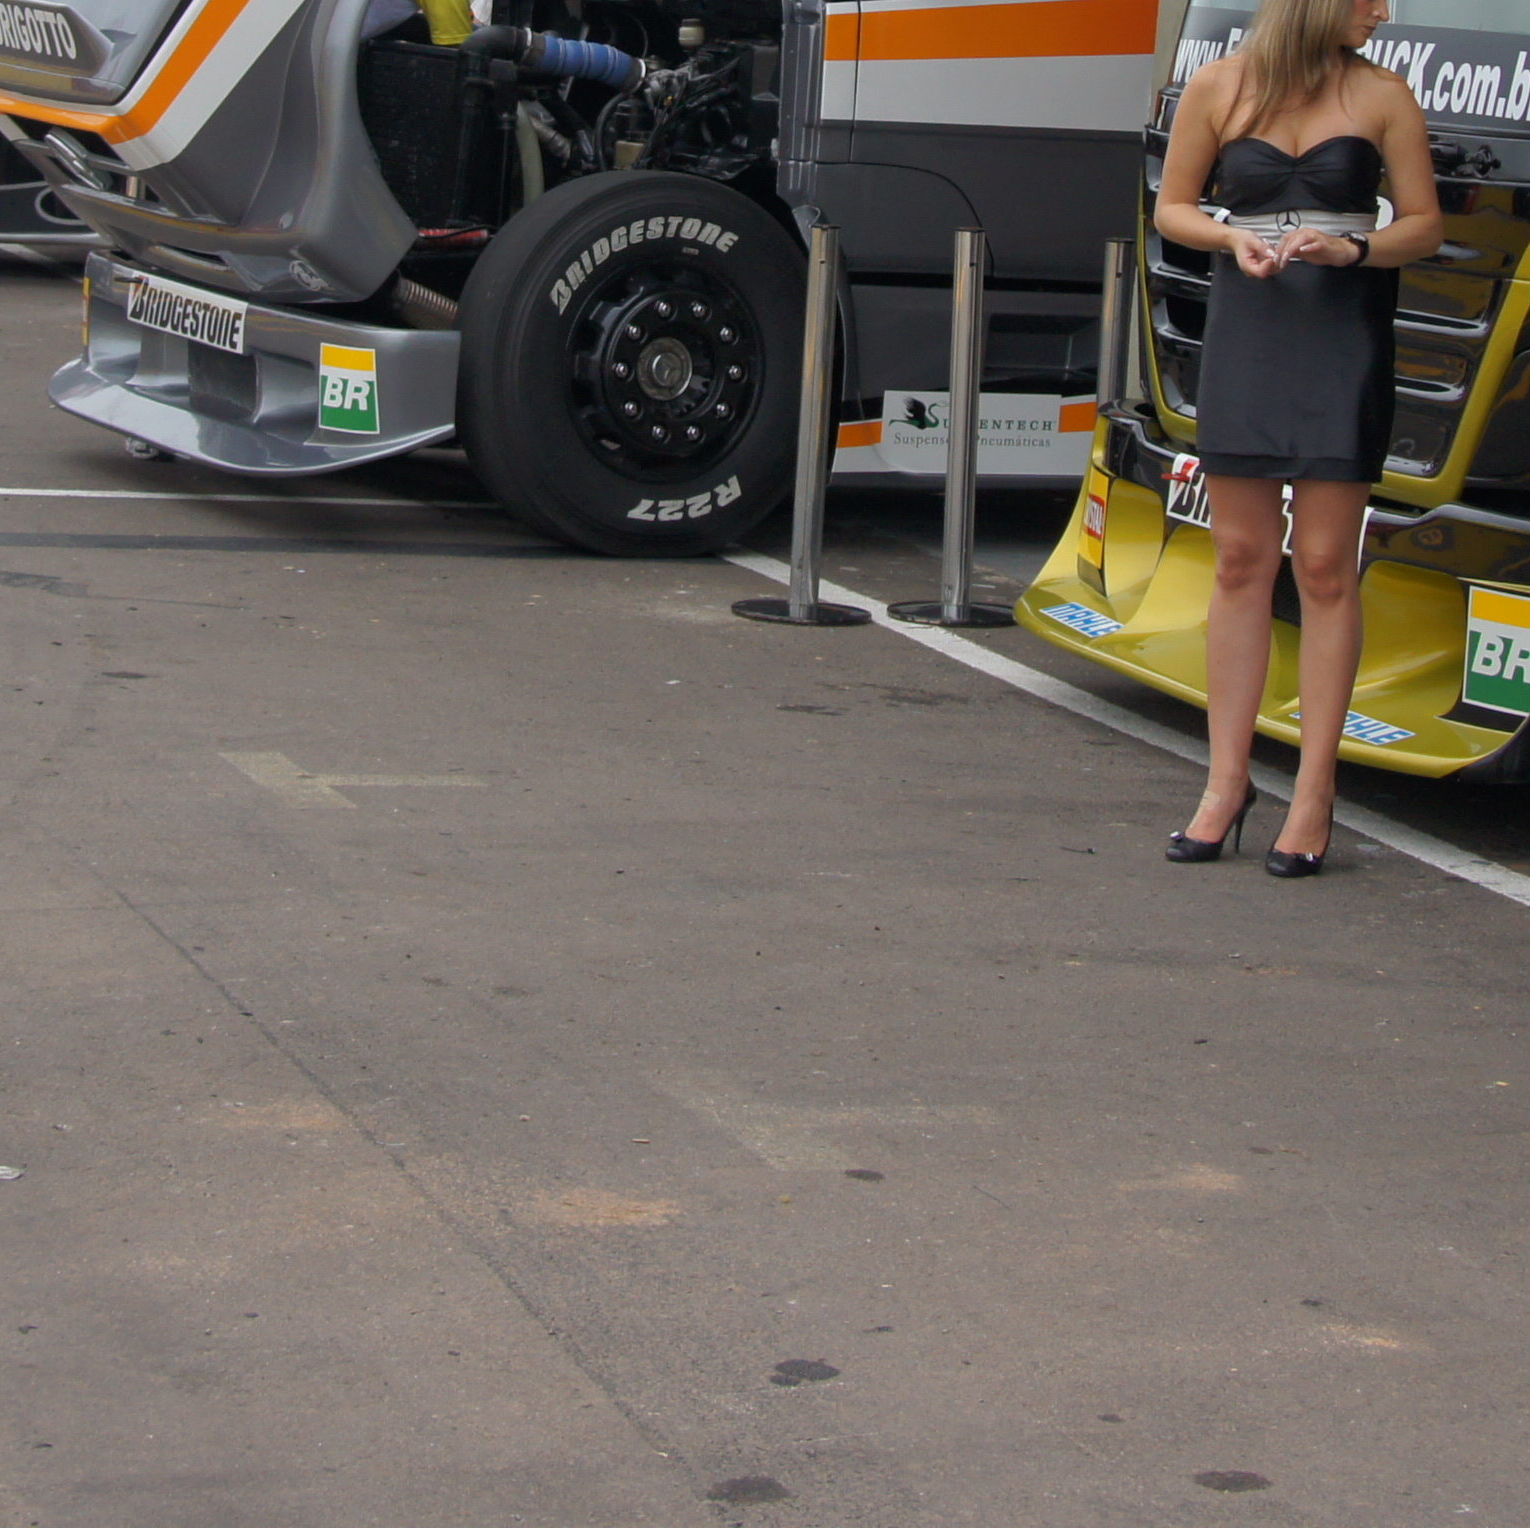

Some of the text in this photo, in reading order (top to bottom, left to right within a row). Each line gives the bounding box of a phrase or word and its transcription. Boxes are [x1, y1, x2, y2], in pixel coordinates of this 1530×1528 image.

[549, 215, 740, 316] BRIDGESTONE
[129, 278, 243, 350] BRIDGESTONE
[323, 375, 371, 412] BR
[627, 474, 743, 522] R227
